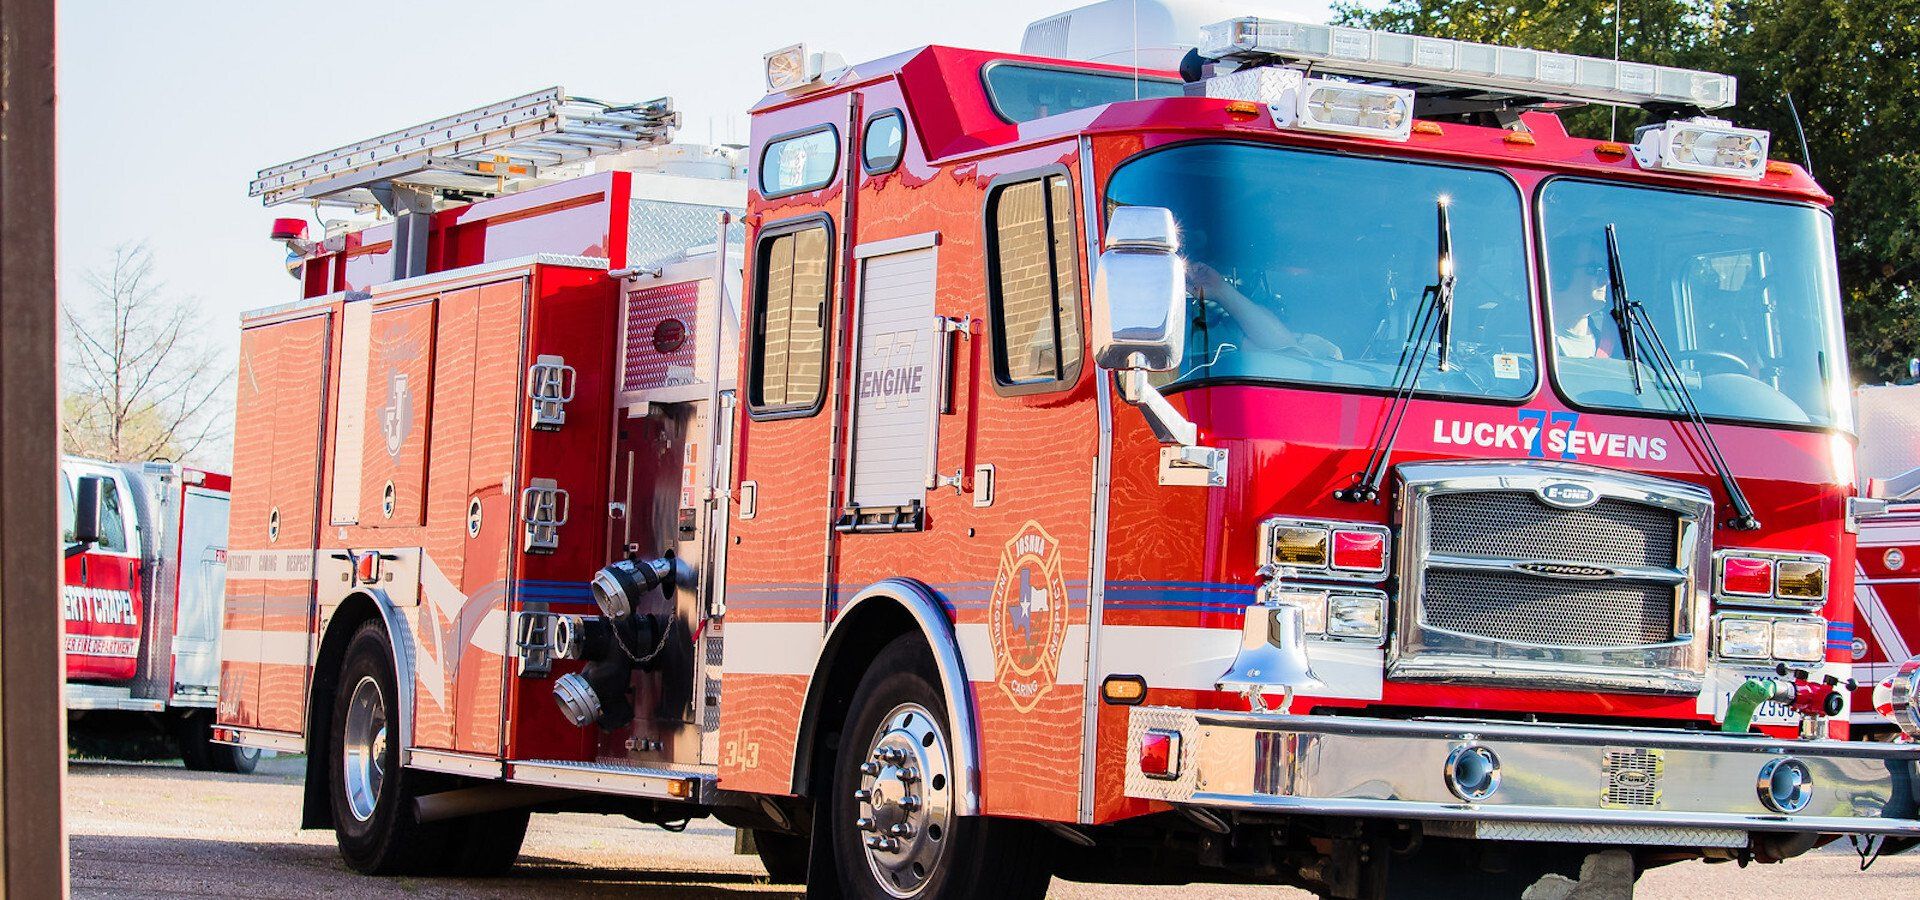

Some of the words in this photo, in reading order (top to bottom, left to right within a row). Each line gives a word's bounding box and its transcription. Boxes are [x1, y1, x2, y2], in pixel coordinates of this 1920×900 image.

[861, 366, 923, 398] ENGINE
[1433, 419, 1540, 450] LUCKY
[1547, 428, 1667, 461] SEVENS
[1518, 409, 1580, 460] 77
[1548, 487, 1589, 499] E-ONE
[1015, 534, 1045, 557] JOSHUA
[1524, 563, 1608, 575] TYPHOON
[93, 587, 137, 625] CHAPEL
[1049, 578, 1061, 659] RESPECT
[77, 637, 92, 654] FIRE
[93, 639, 135, 656] DEPARTMENT
[1011, 679, 1039, 697] CARING
[724, 728, 760, 773] 343
